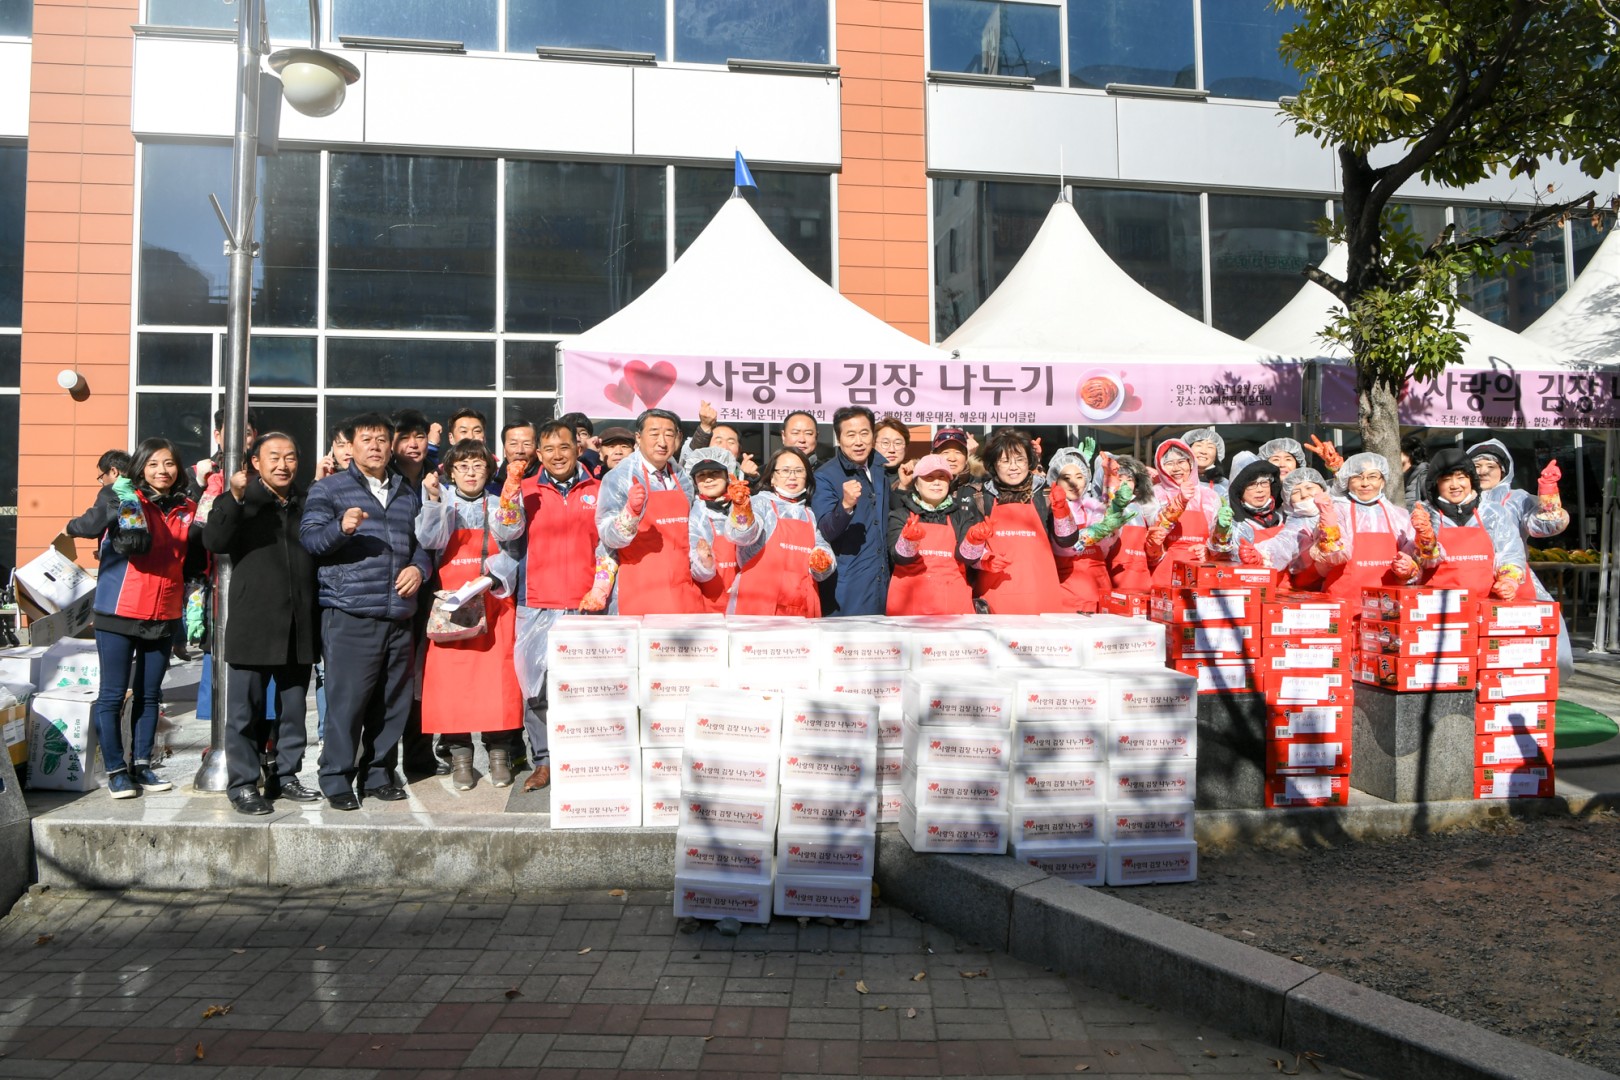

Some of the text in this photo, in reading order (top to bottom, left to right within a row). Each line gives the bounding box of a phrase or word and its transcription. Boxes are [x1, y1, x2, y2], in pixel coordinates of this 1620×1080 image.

[696, 360, 1054, 407] 사랑의 김장 나누기
[1176, 384, 1196, 394] 일자:
[1426, 372, 1522, 412] 사랑의
[1537, 374, 1602, 413] 김장
[1176, 396, 1196, 407] 장소:
[720, 408, 743, 420] 주최:
[916, 411, 956, 423] 해운대점,
[960, 411, 987, 423] 해운대
[991, 411, 1036, 423] 시니어클럽
[1441, 415, 1458, 426] 주최:
